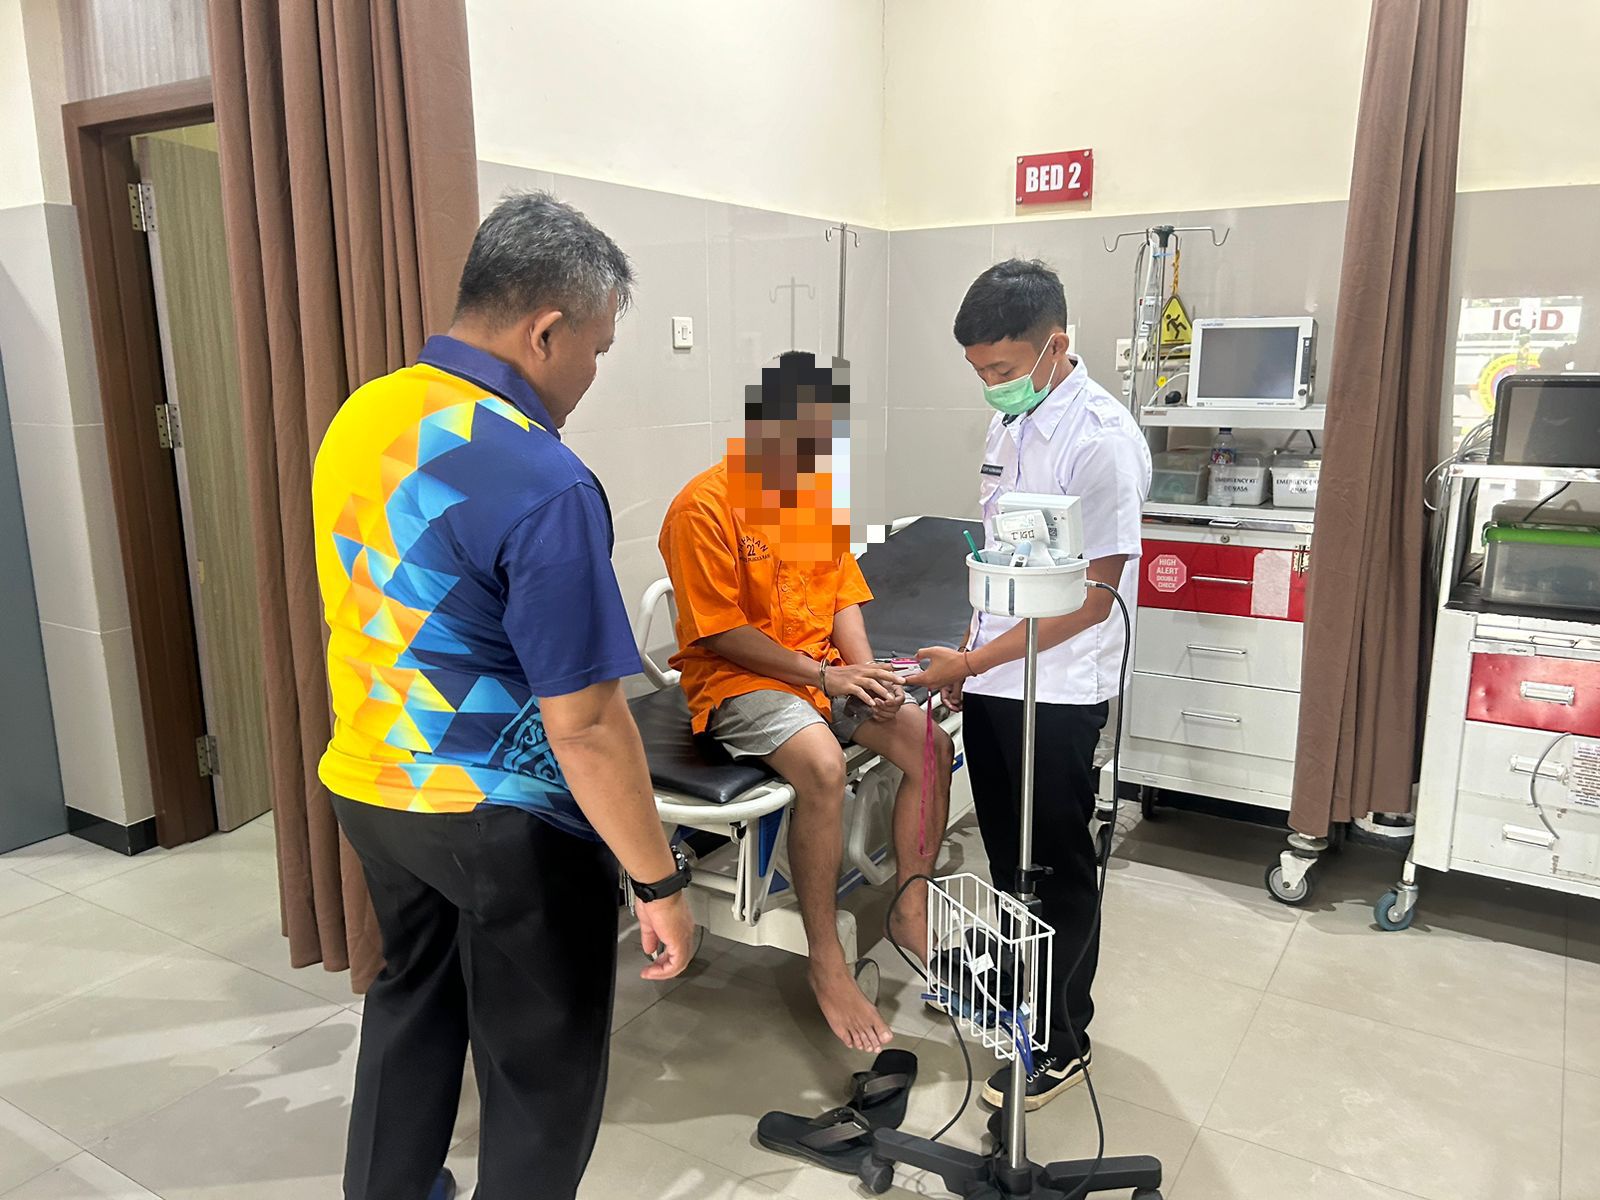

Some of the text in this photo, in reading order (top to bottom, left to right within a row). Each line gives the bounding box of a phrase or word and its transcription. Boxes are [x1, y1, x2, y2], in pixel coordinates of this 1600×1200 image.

[1025, 162, 1082, 193] BED 2
[1492, 308, 1564, 331] IGD
[1159, 558, 1176, 566] HIGH
[1156, 567, 1178, 575] ALERT
